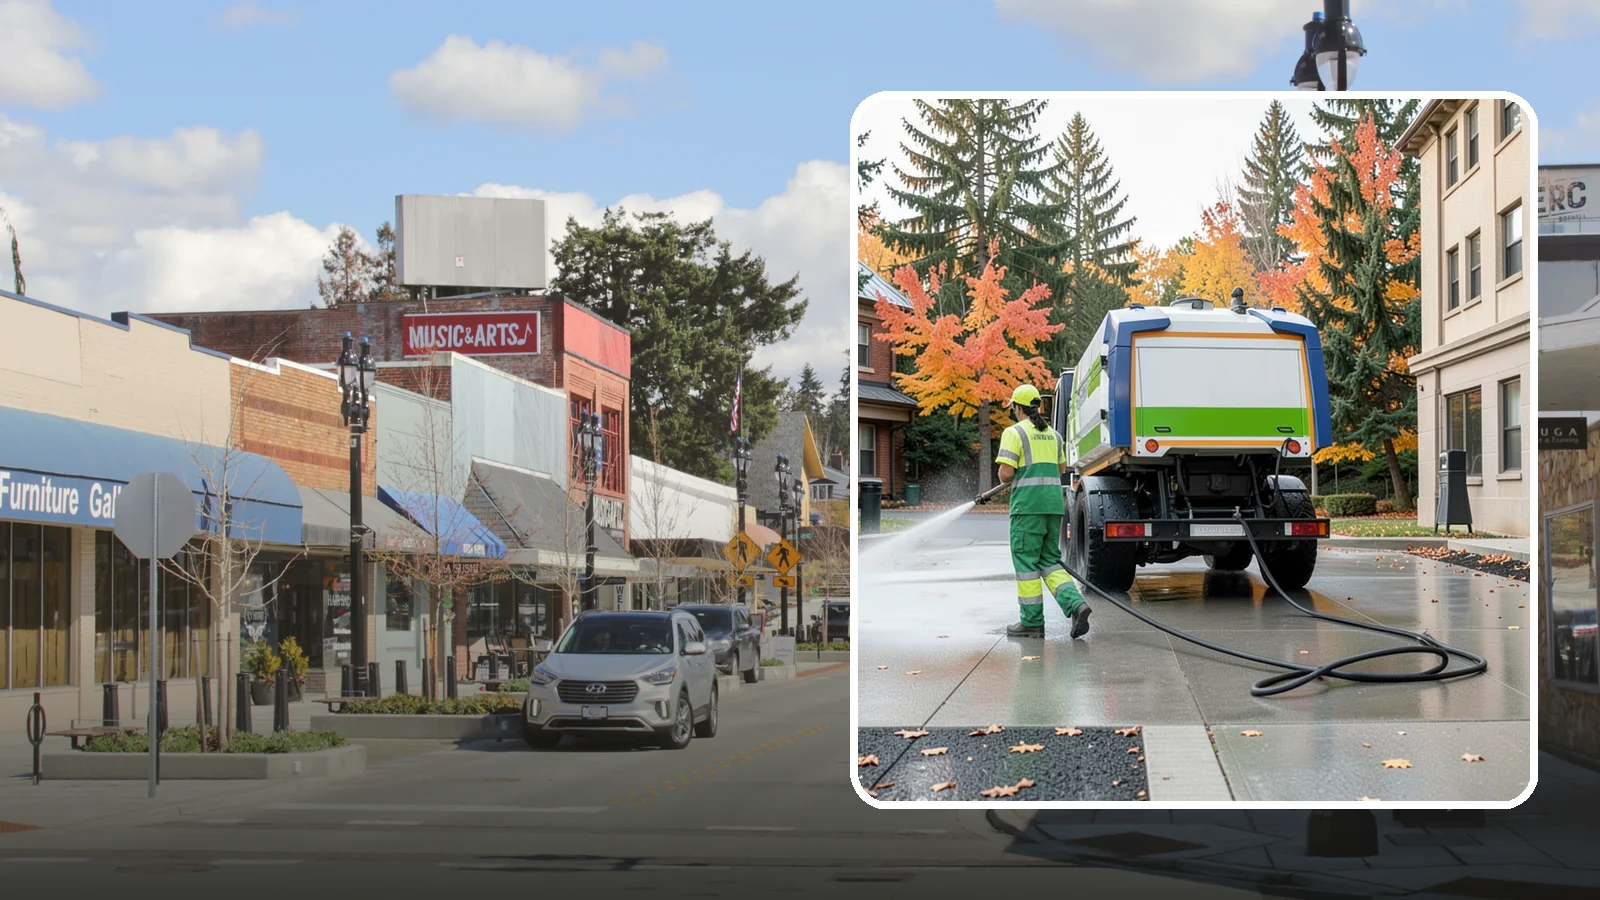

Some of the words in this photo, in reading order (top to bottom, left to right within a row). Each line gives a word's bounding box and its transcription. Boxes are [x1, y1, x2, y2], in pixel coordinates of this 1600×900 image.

[408, 323, 519, 349] MUSIC&ARTS
[0, 471, 79, 515] Furniture
[453, 563, 479, 574] SUSHI
